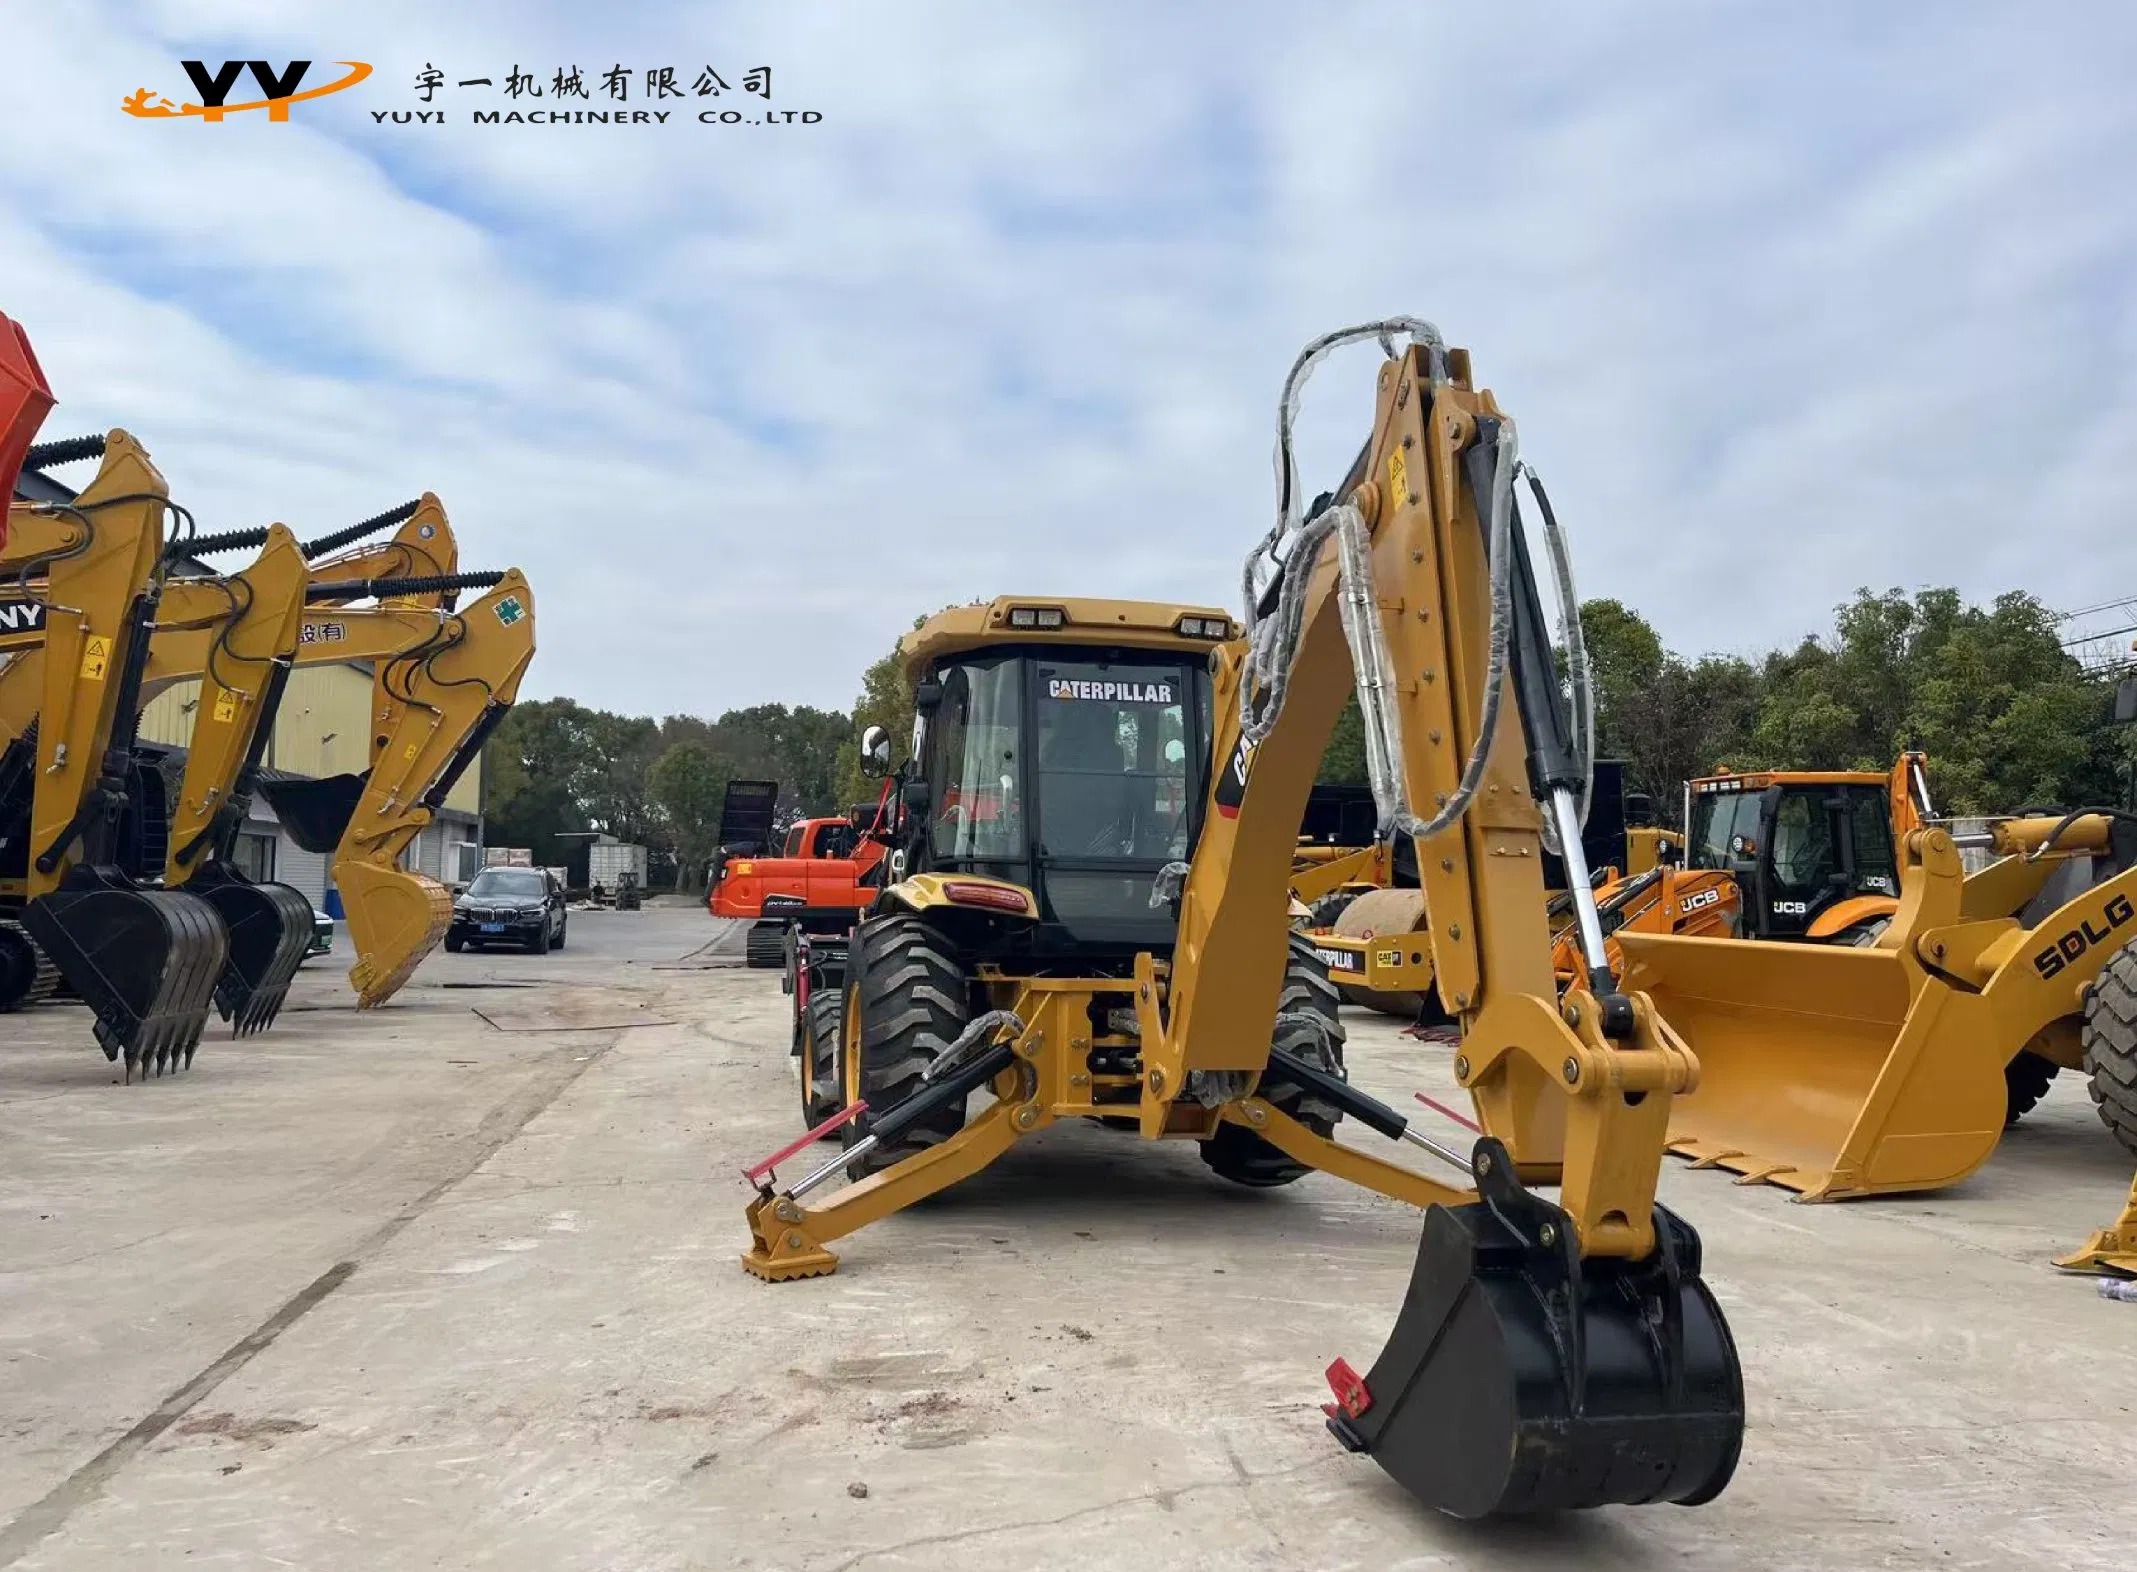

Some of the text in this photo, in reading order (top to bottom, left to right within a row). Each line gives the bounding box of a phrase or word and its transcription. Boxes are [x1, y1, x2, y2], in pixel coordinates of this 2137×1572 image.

[1049, 679, 1172, 702] CATERPILLAR
[1867, 876, 1886, 887] JCB
[1680, 890, 1719, 912] JCB
[1774, 901, 1806, 914] JCB
[2034, 893, 2134, 980] SDLG
